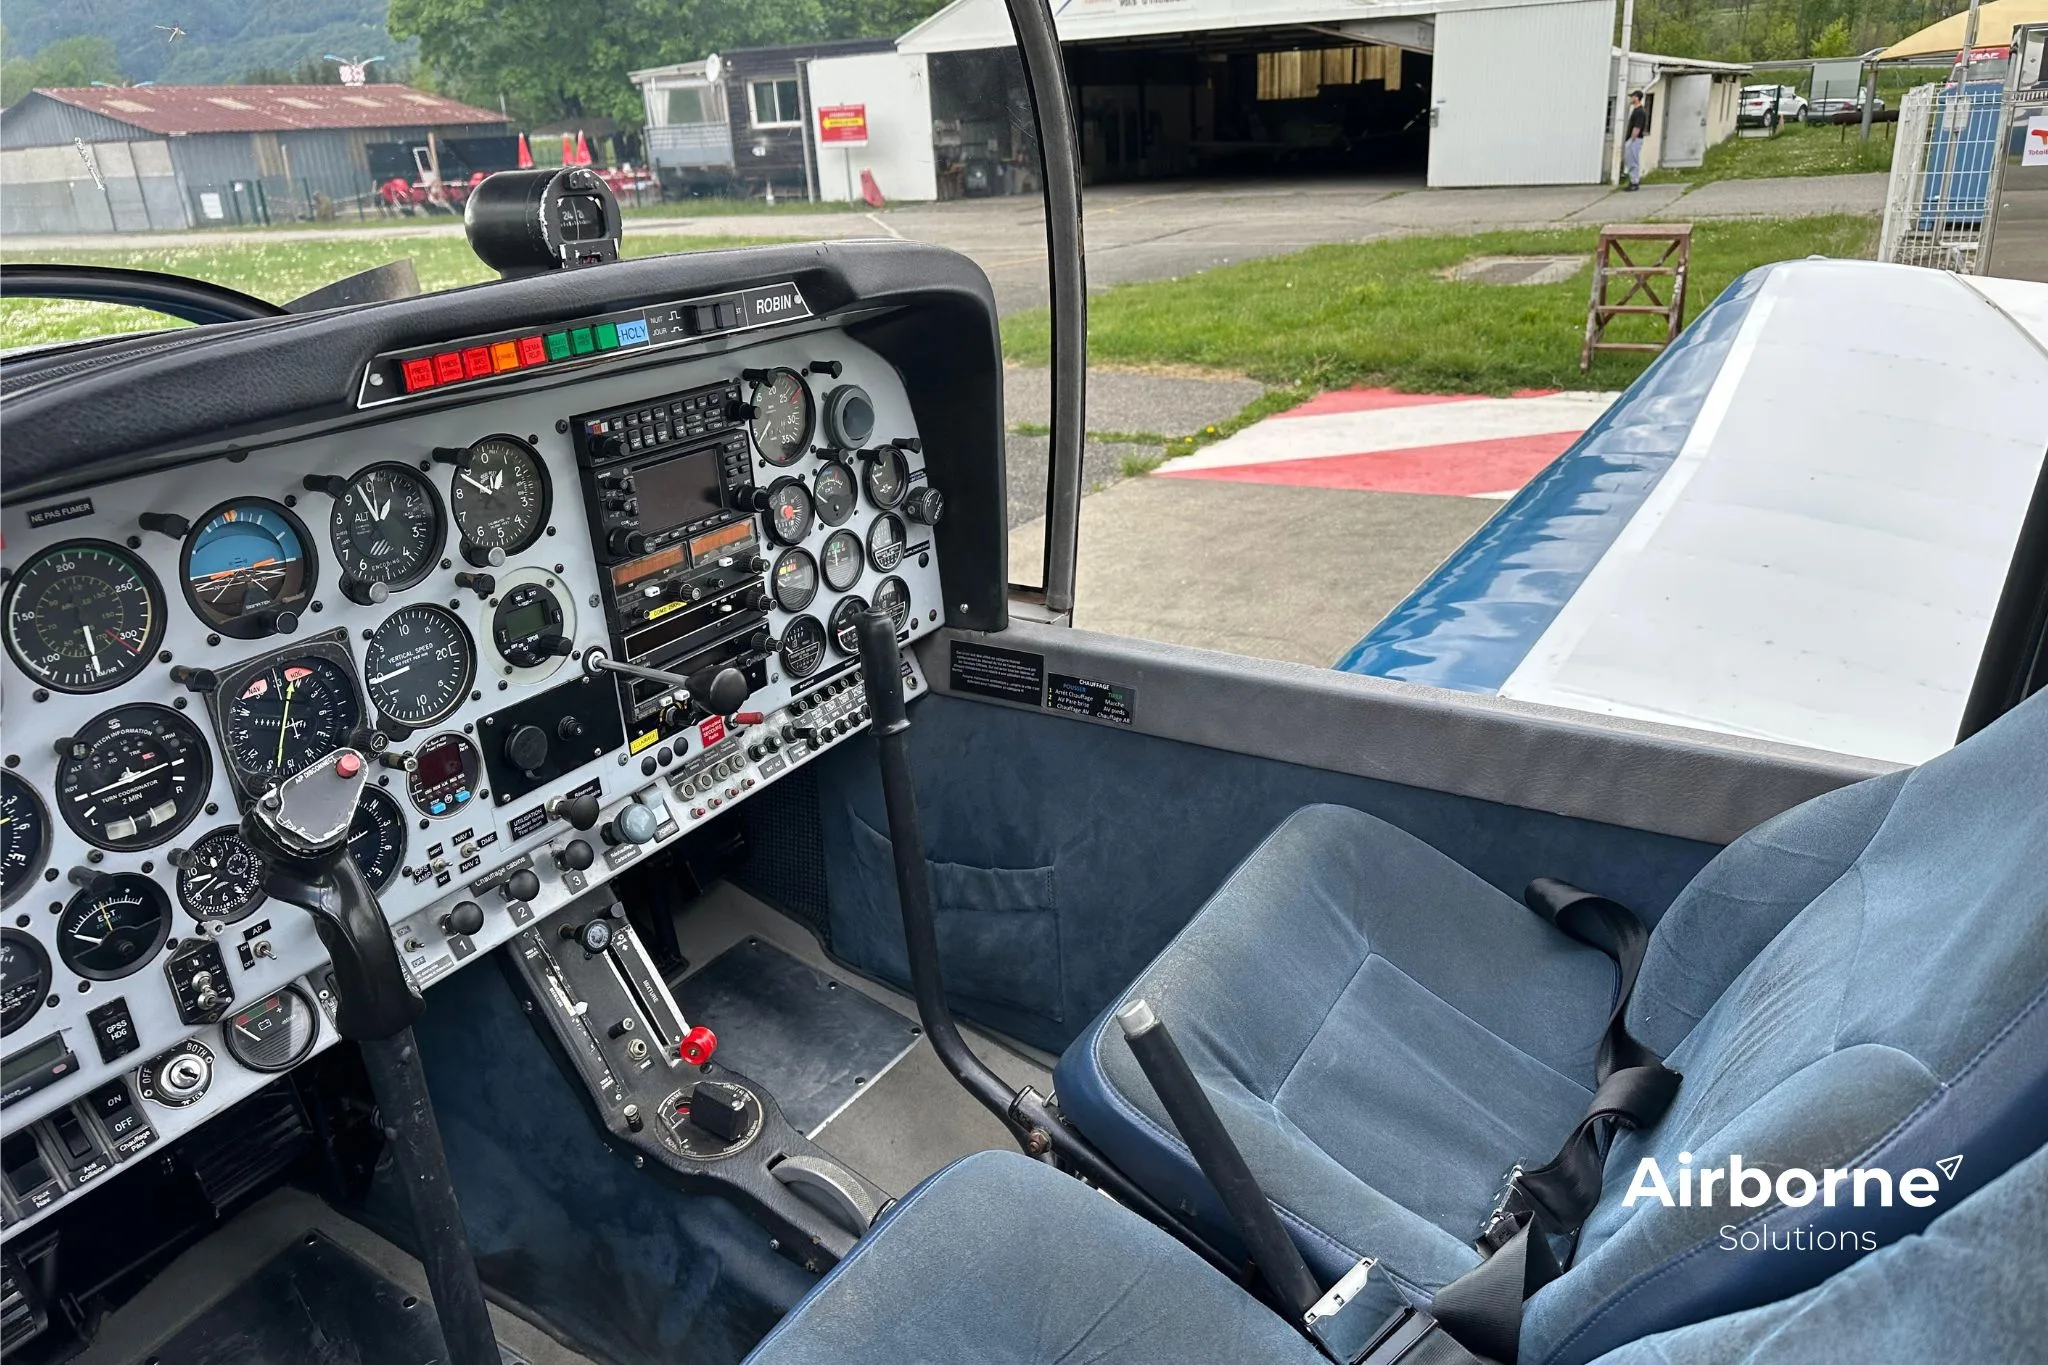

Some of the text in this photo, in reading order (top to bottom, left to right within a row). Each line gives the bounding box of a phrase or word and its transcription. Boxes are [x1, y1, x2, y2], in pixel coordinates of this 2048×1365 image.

[756, 294, 792, 315] ROBIN
[650, 316, 663, 324] NUIT
[652, 327, 668, 337] JOUR
[768, 386, 777, 396] 20
[779, 394, 788, 403] 25
[787, 416, 796, 425] 30
[781, 435, 790, 444] 35
[481, 452, 489, 464] 0
[514, 466, 522, 477] 2
[366, 481, 373, 493] 0
[456, 488, 464, 499] 8
[345, 494, 353, 506] 9
[406, 495, 413, 508] 2
[520, 496, 529, 507] 3
[31, 503, 91, 523] NE PAS FUMER
[354, 511, 369, 523] ALT
[459, 511, 467, 523] 7
[336, 513, 343, 525] 8
[514, 514, 522, 524] 4
[411, 526, 420, 538] 3
[477, 526, 485, 537] 6
[497, 527, 505, 538] 5
[342, 549, 350, 561] 7
[402, 546, 410, 557] 4
[56, 561, 76, 573] 200
[360, 558, 368, 571] 6
[115, 582, 133, 593] 250
[17, 612, 35, 622] 150
[120, 630, 138, 640] 300
[399, 624, 410, 637] 10
[42, 654, 60, 664] 100
[387, 642, 434, 665] VERTICAL SPEED
[290, 670, 303, 679] HDG
[248, 685, 261, 695] NAV
[1063, 683, 1087, 693] POUSSER
[1079, 679, 1111, 691] CHAUFFAGE
[416, 694, 427, 707] 10
[1068, 690, 1094, 702] Chauffage
[1056, 703, 1081, 714] Chauffage
[1104, 699, 1125, 708] Marche
[1096, 712, 1123, 723] Chauffage
[1111, 708, 1125, 716] pieds
[93, 728, 153, 751] PITCH INFORMATION
[161, 732, 176, 742] TRIM
[708, 732, 719, 741] Radio
[129, 749, 141, 757] TRK
[70, 765, 83, 773] ALT
[304, 755, 336, 779] DISCONNECT
[64, 785, 79, 794] RDY
[101, 779, 158, 804] TURN COORDINATOR
[175, 786, 183, 794] R
[7, 795, 18, 805] 3
[128, 792, 143, 803] MIN
[369, 799, 378, 810] N
[91, 818, 99, 826] L
[513, 808, 543, 826] UTILISATION
[18, 822, 31, 831] 6
[383, 819, 391, 827] 3
[514, 818, 533, 833] Pousser
[455, 833, 468, 843] NAV
[481, 834, 495, 846] DME
[14, 852, 26, 863] E
[414, 865, 429, 877] GPS
[462, 860, 474, 871] NAV
[475, 856, 526, 886] Chauffage cabine
[187, 867, 198, 878] 10
[372, 867, 383, 878] E
[414, 872, 432, 885] LAMP
[573, 875, 582, 887] 3
[207, 894, 213, 905] 7
[222, 892, 229, 902] 6
[97, 909, 117, 923] EGT
[517, 906, 528, 919] 2
[252, 925, 264, 936] AP
[240, 944, 249, 952] ON
[459, 939, 467, 951] 1
[243, 959, 255, 968] OFF
[643, 980, 660, 1004] MIXTURE
[106, 1020, 128, 1035] GPSS
[110, 1028, 128, 1041] HDG
[186, 1042, 208, 1058] BOTH
[142, 1067, 153, 1085] OFF
[107, 1094, 122, 1107] ON
[114, 1116, 134, 1132] OFF
[119, 1129, 151, 1153] Chauffage
[130, 1140, 147, 1152] Pilot
[79, 1163, 107, 1183] Collision
[83, 1162, 98, 1174] Anti
